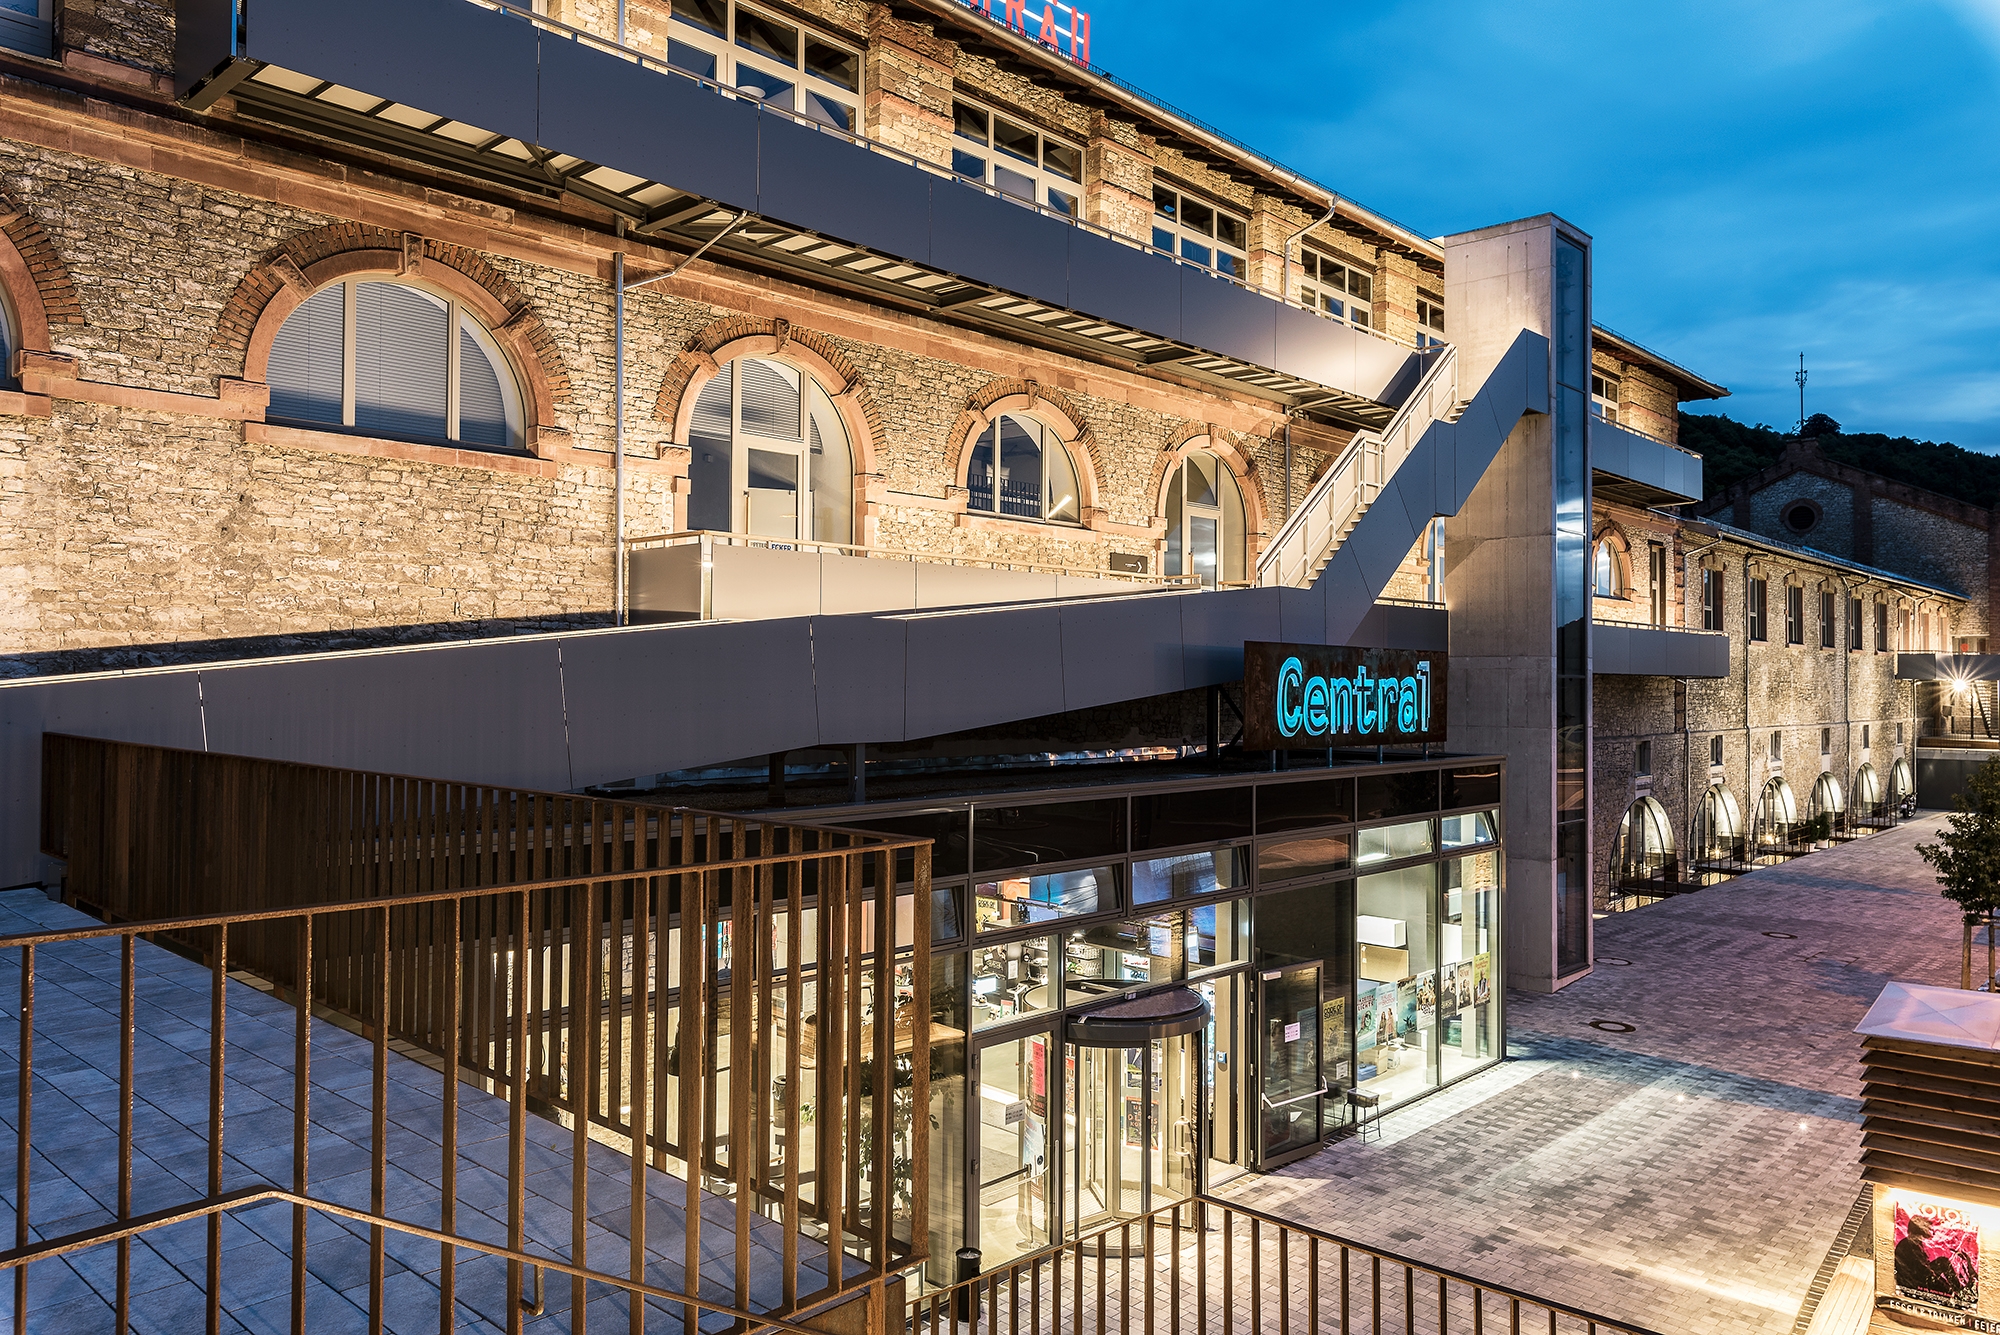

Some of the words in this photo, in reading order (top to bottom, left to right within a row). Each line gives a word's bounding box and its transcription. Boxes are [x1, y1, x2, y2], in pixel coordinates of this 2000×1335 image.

[1277, 656, 1431, 738] Central
[1889, 1299, 1918, 1314] ESSEN
[1927, 1309, 1966, 1326] TRINKEN
